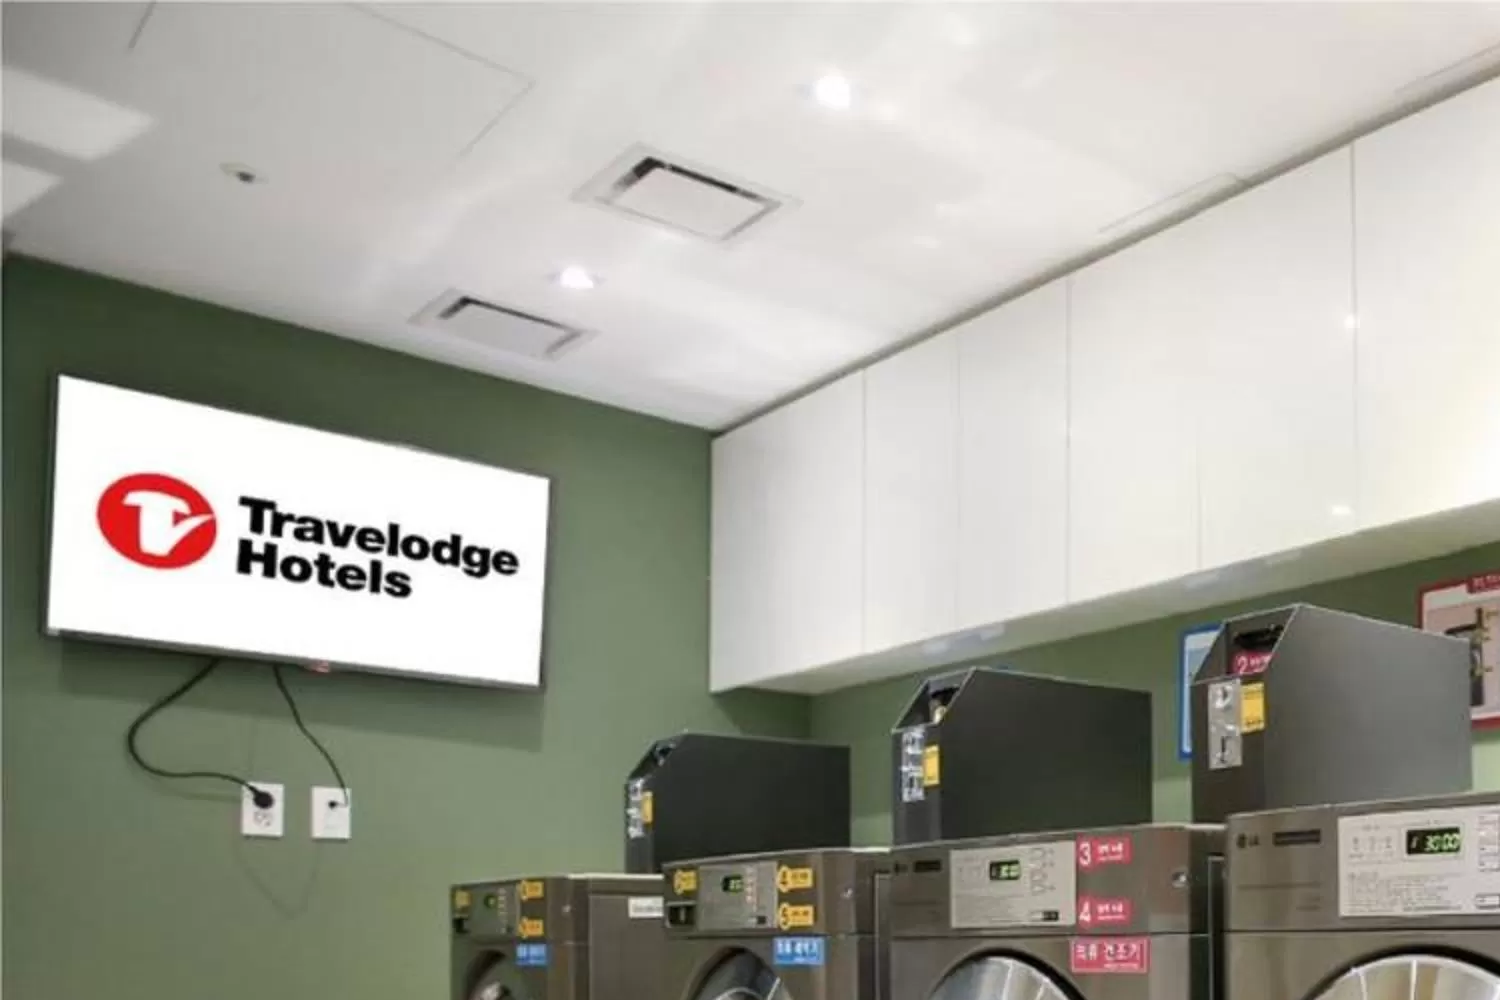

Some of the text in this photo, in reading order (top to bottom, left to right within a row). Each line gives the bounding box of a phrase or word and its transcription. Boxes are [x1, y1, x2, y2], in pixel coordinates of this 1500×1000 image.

[236, 537, 413, 598] Hotels
[238, 495, 520, 579] Travelodge
[1080, 841, 1091, 866] 3
